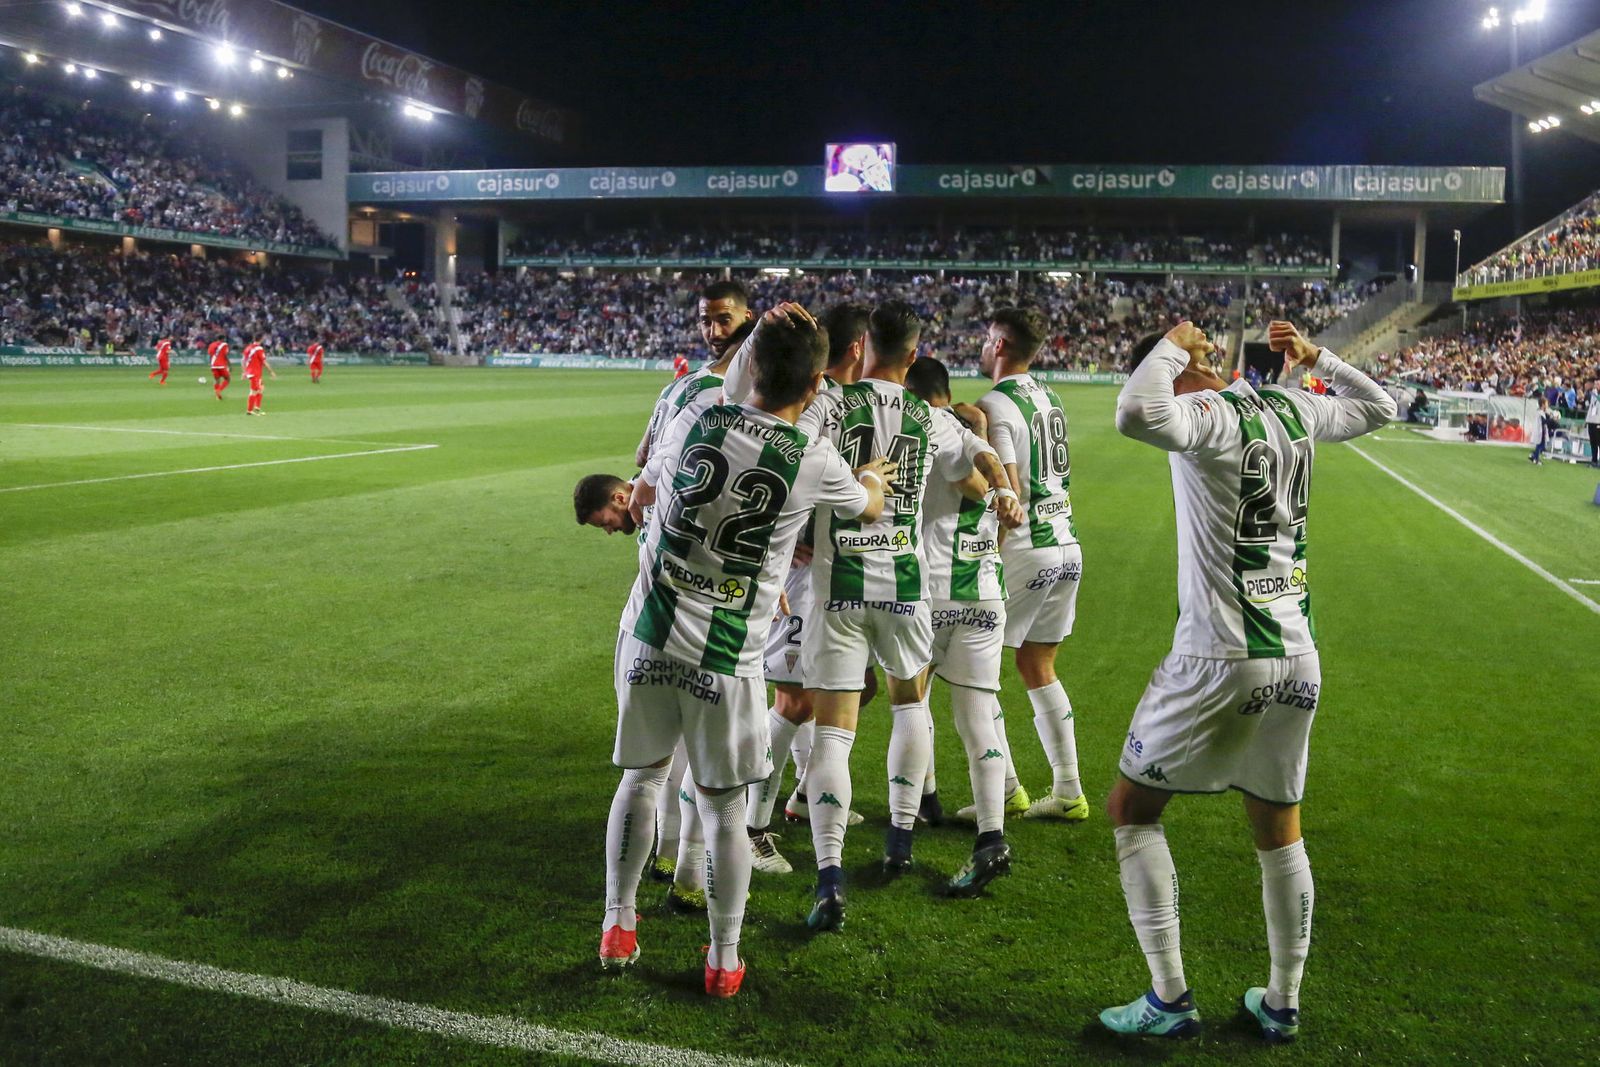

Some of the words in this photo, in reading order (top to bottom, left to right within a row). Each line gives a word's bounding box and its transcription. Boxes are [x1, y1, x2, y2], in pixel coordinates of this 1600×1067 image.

[372, 175, 434, 197] cajasur
[477, 174, 544, 196] cajasur
[589, 171, 660, 193] cajasur
[707, 171, 781, 193] cajasur
[939, 169, 1019, 192] cajasur
[1072, 169, 1156, 192] cajasur
[1211, 170, 1298, 194] cajasur
[1353, 172, 1442, 196] cajasur
[46, 356, 75, 365] desde
[824, 391, 867, 430] SERGI
[866, 391, 939, 458] GUARDIOLA
[1031, 406, 1071, 483] 18
[840, 422, 922, 515] 14
[1234, 439, 1313, 544] 24
[660, 443, 792, 567] 22
[931, 607, 998, 621] CORHYUND
